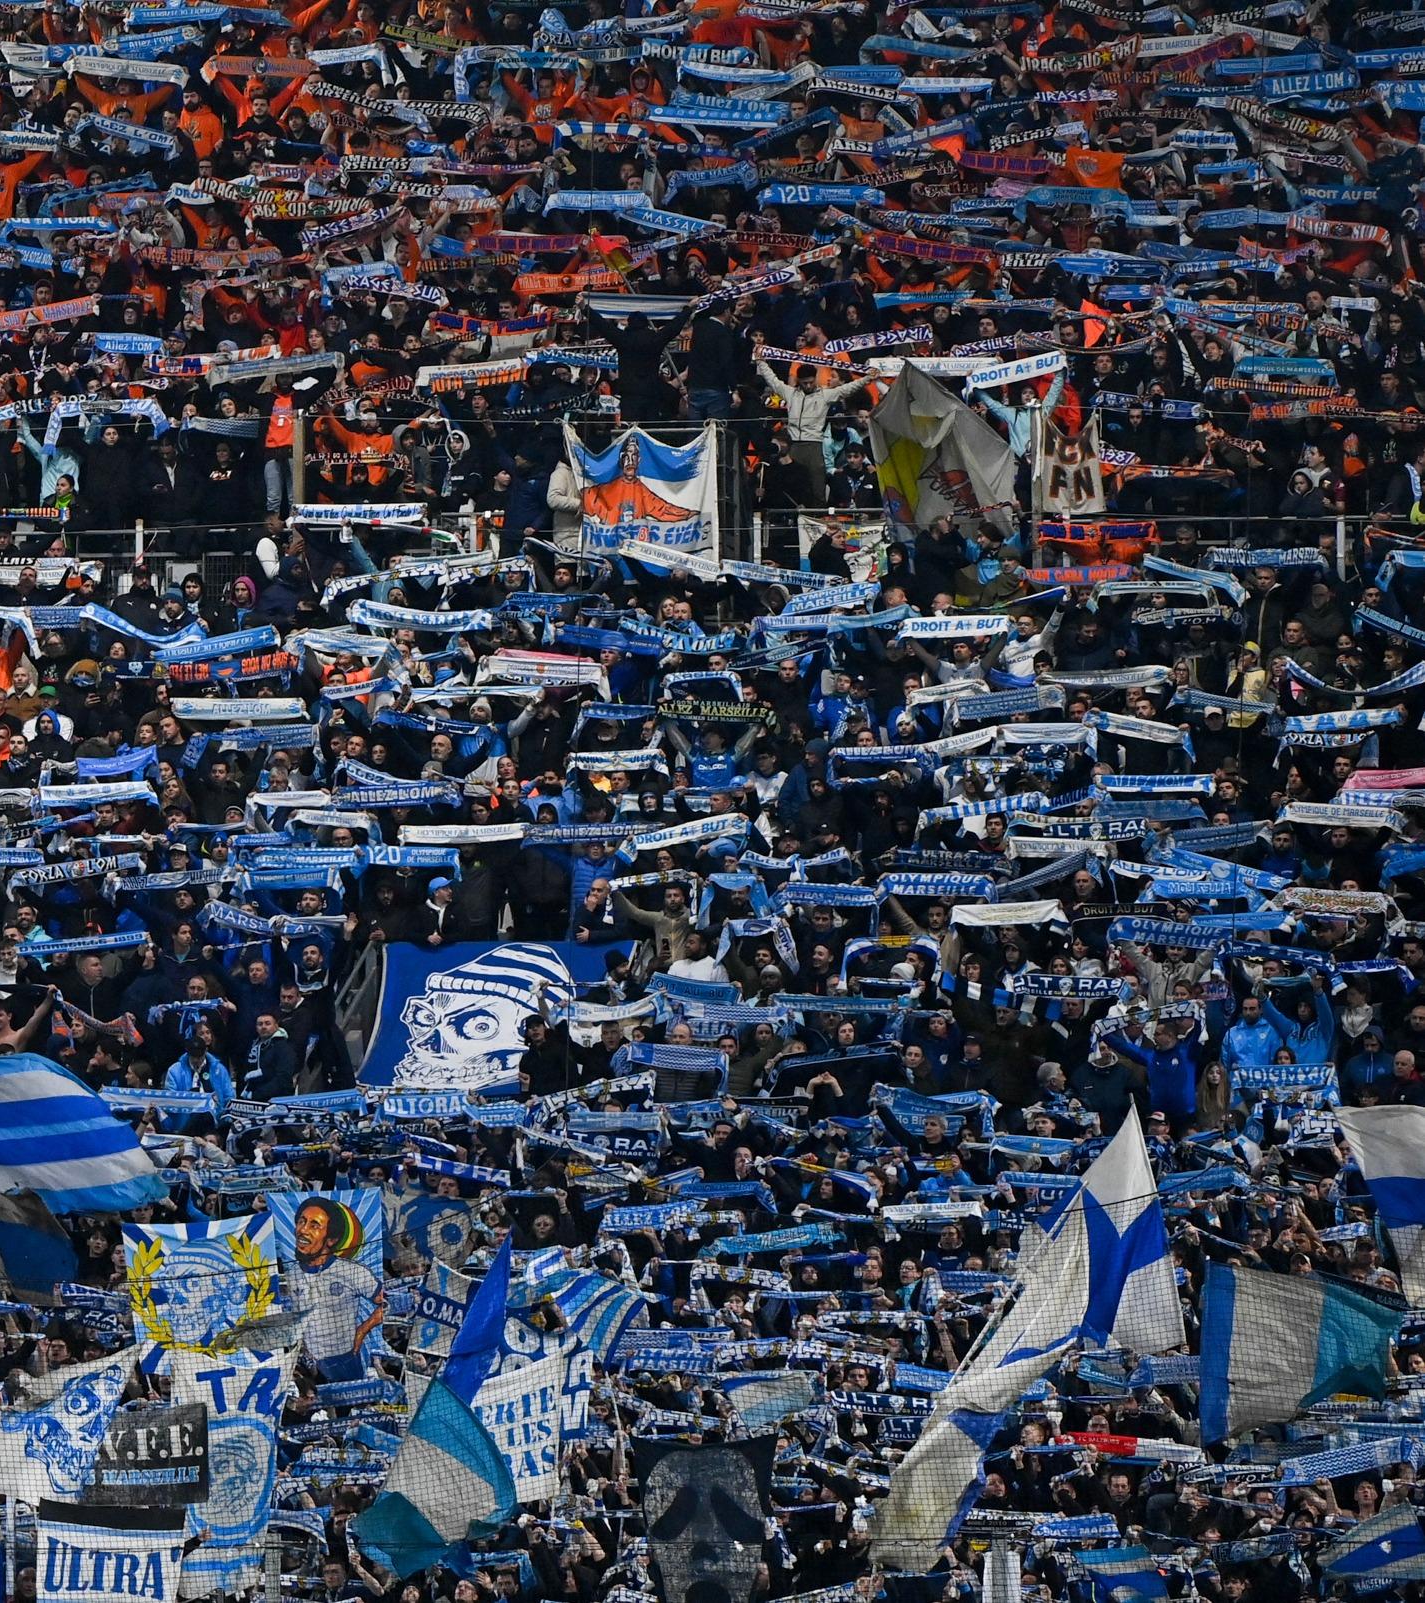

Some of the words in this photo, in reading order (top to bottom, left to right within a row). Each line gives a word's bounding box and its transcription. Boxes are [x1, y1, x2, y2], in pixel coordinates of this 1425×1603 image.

[1166, 38, 1202, 50] MARSEILLE
[643, 42, 684, 61] DROIT
[689, 45, 709, 61] AU
[710, 48, 739, 64] BUT
[1272, 76, 1310, 92] ALLEZ
[1315, 72, 1345, 88] L'OM
[696, 97, 733, 109] Allez
[196, 179, 238, 199] VIRAGE
[972, 368, 1010, 385] DROIT
[1036, 356, 1063, 371] BUT
[1101, 449, 1136, 464] 1987
[912, 620, 952, 632] DROIT
[954, 620, 973, 631] A+
[976, 617, 1004, 630] BUT
[702, 705, 769, 718] MARSEILLE
[1343, 807, 1384, 818] MARSEILLE
[637, 831, 666, 844] DROIT
[701, 819, 729, 833] BUT
[297, 855, 354, 864] MARSEILLE
[369, 847, 401, 864] 120
[411, 849, 446, 857] OLYMPIQUE
[889, 873, 983, 885] OLYMPIQUE
[895, 885, 977, 896] MARSEILLE
[1131, 921, 1222, 935] OLYMPIQUE
[1134, 931, 1217, 947] MARSEILLE
